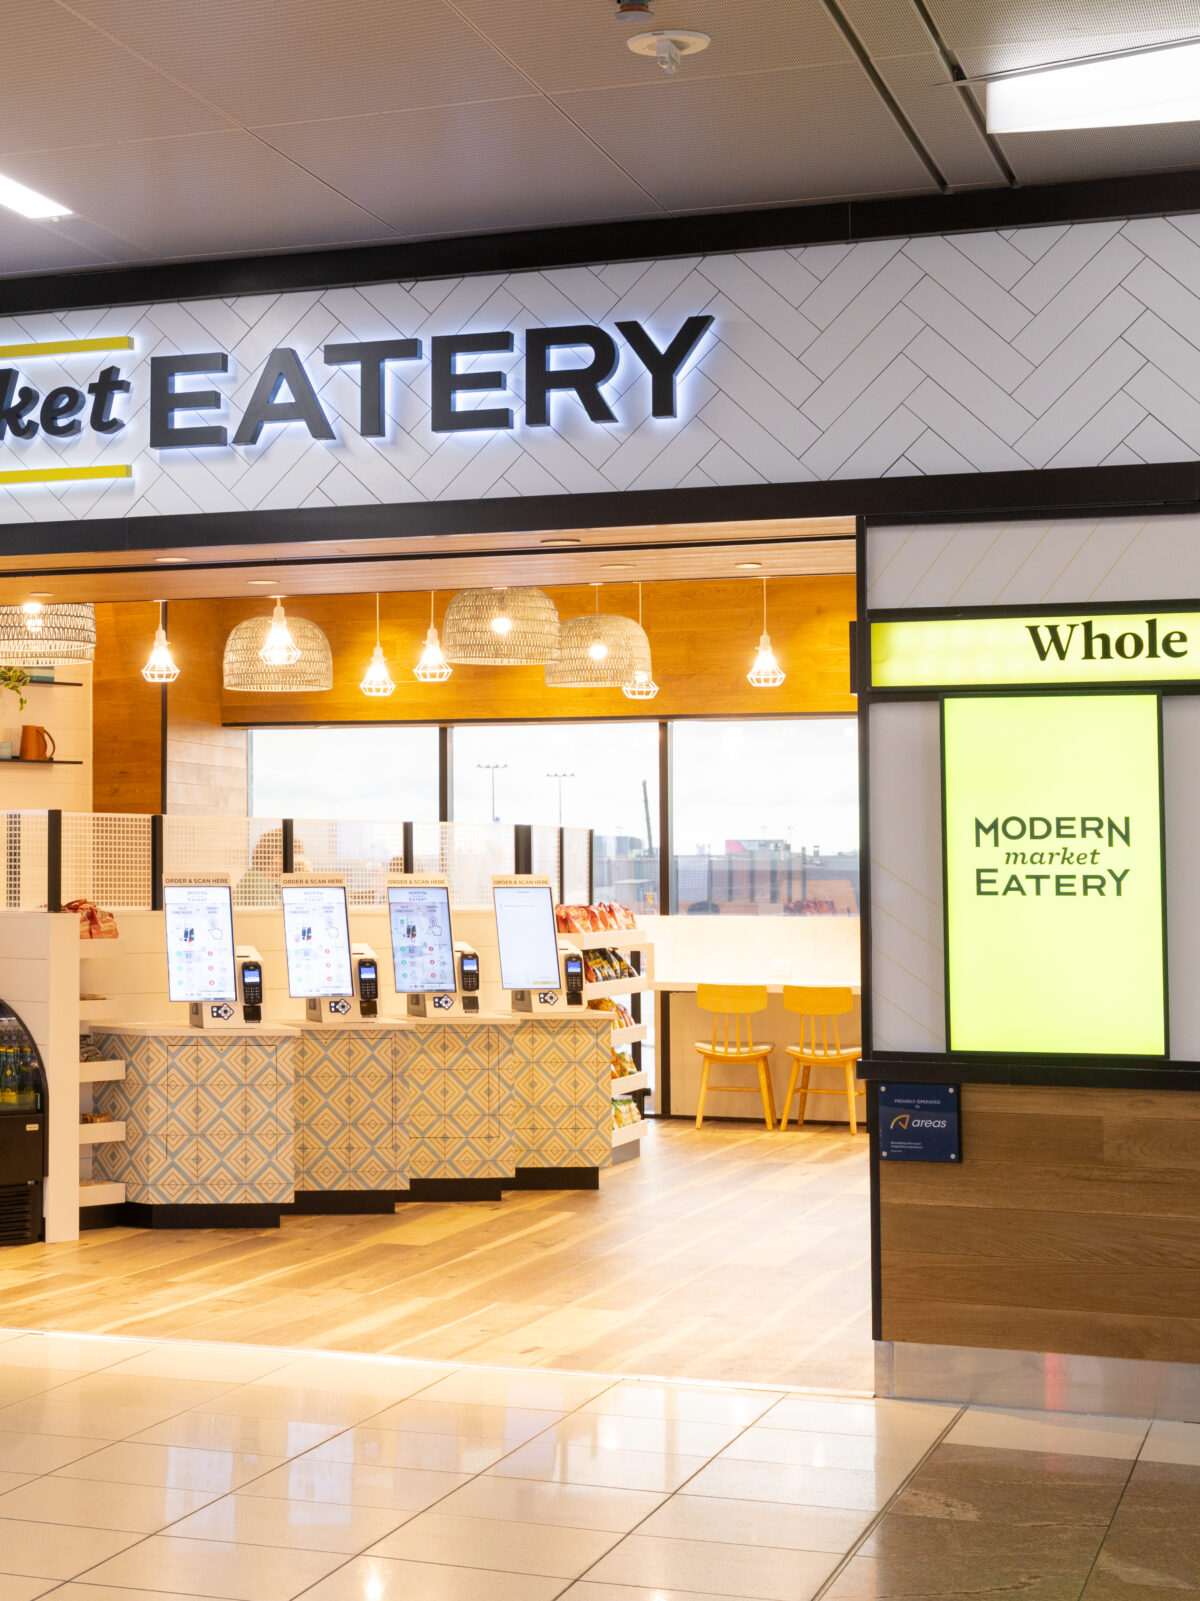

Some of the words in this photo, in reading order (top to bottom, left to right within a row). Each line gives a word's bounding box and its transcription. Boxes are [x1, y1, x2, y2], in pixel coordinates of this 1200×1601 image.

[150, 315, 715, 449] EATERY
[1025, 618, 1189, 662] Whole
[974, 816, 1131, 848] MODERN
[1004, 847, 1101, 866] market
[975, 867, 1131, 897] EATERY
[911, 1119, 947, 1128] areas
